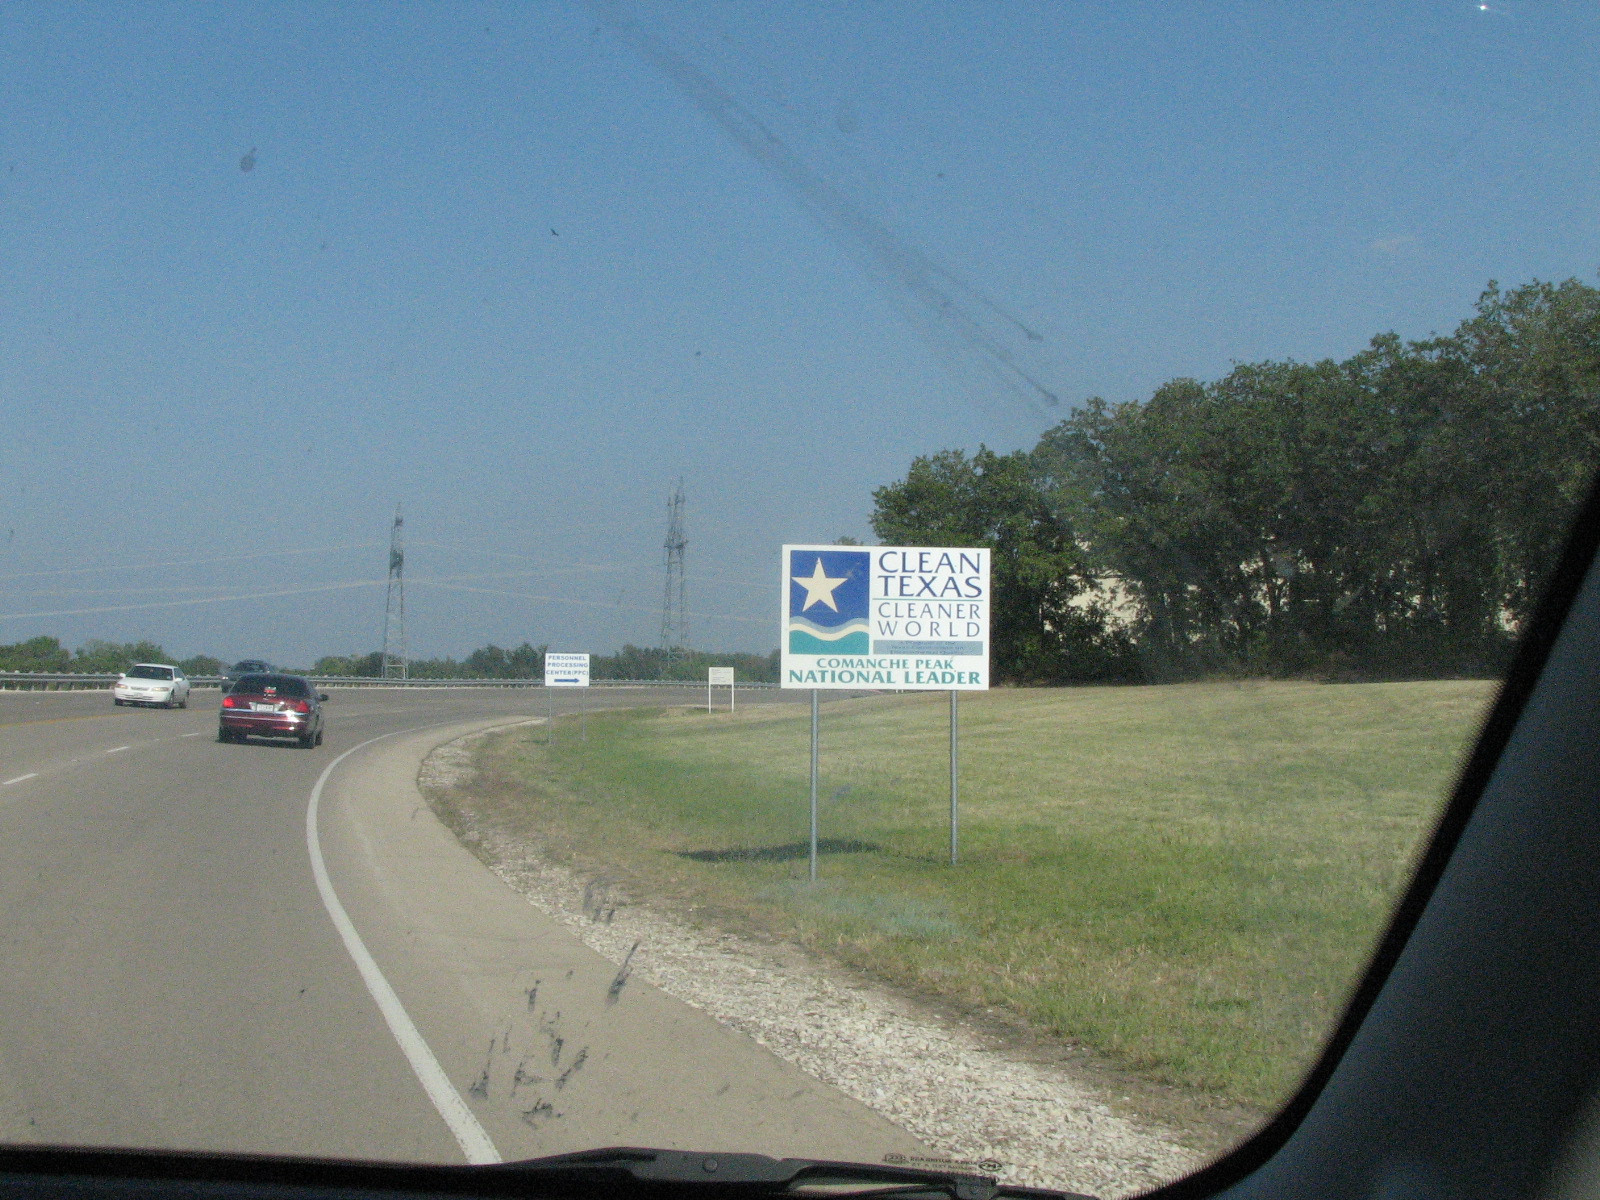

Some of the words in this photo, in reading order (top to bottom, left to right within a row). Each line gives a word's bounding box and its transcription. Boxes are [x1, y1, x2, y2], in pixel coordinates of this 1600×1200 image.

[878, 551, 981, 574] CLEAN
[877, 575, 983, 598] TEXAS
[878, 602, 981, 619] CLEANER
[877, 620, 980, 637] WORLD
[816, 658, 909, 669] COMANCHE
[915, 659, 954, 670] PEAK
[789, 669, 896, 684] NATIONAL
[904, 671, 981, 685] LEADER
